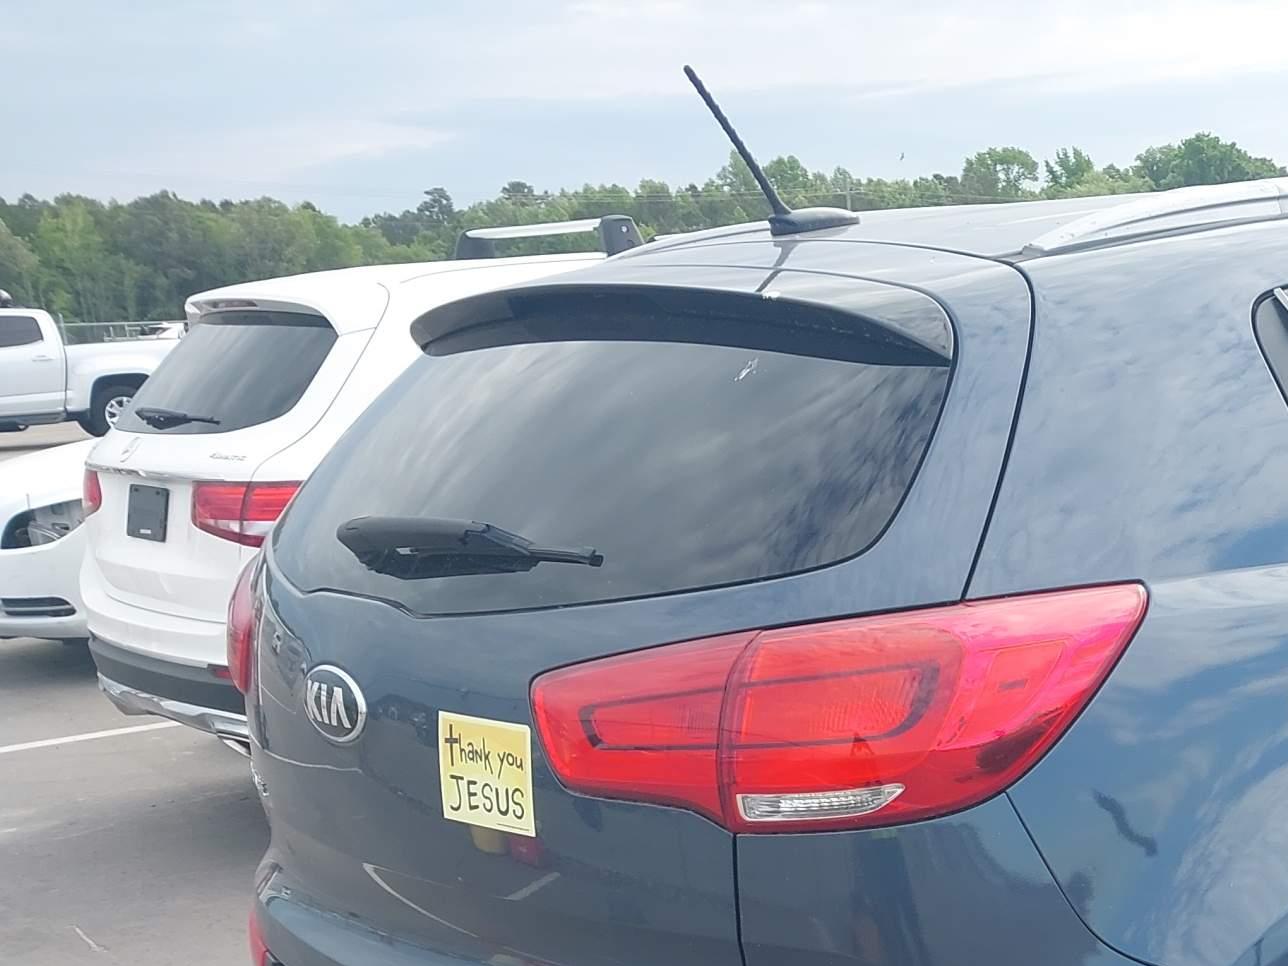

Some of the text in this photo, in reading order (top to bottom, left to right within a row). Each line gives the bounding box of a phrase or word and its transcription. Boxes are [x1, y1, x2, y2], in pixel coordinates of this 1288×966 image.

[305, 680, 353, 730] KIA
[497, 751, 525, 780] you
[448, 774, 526, 821] JESUS
